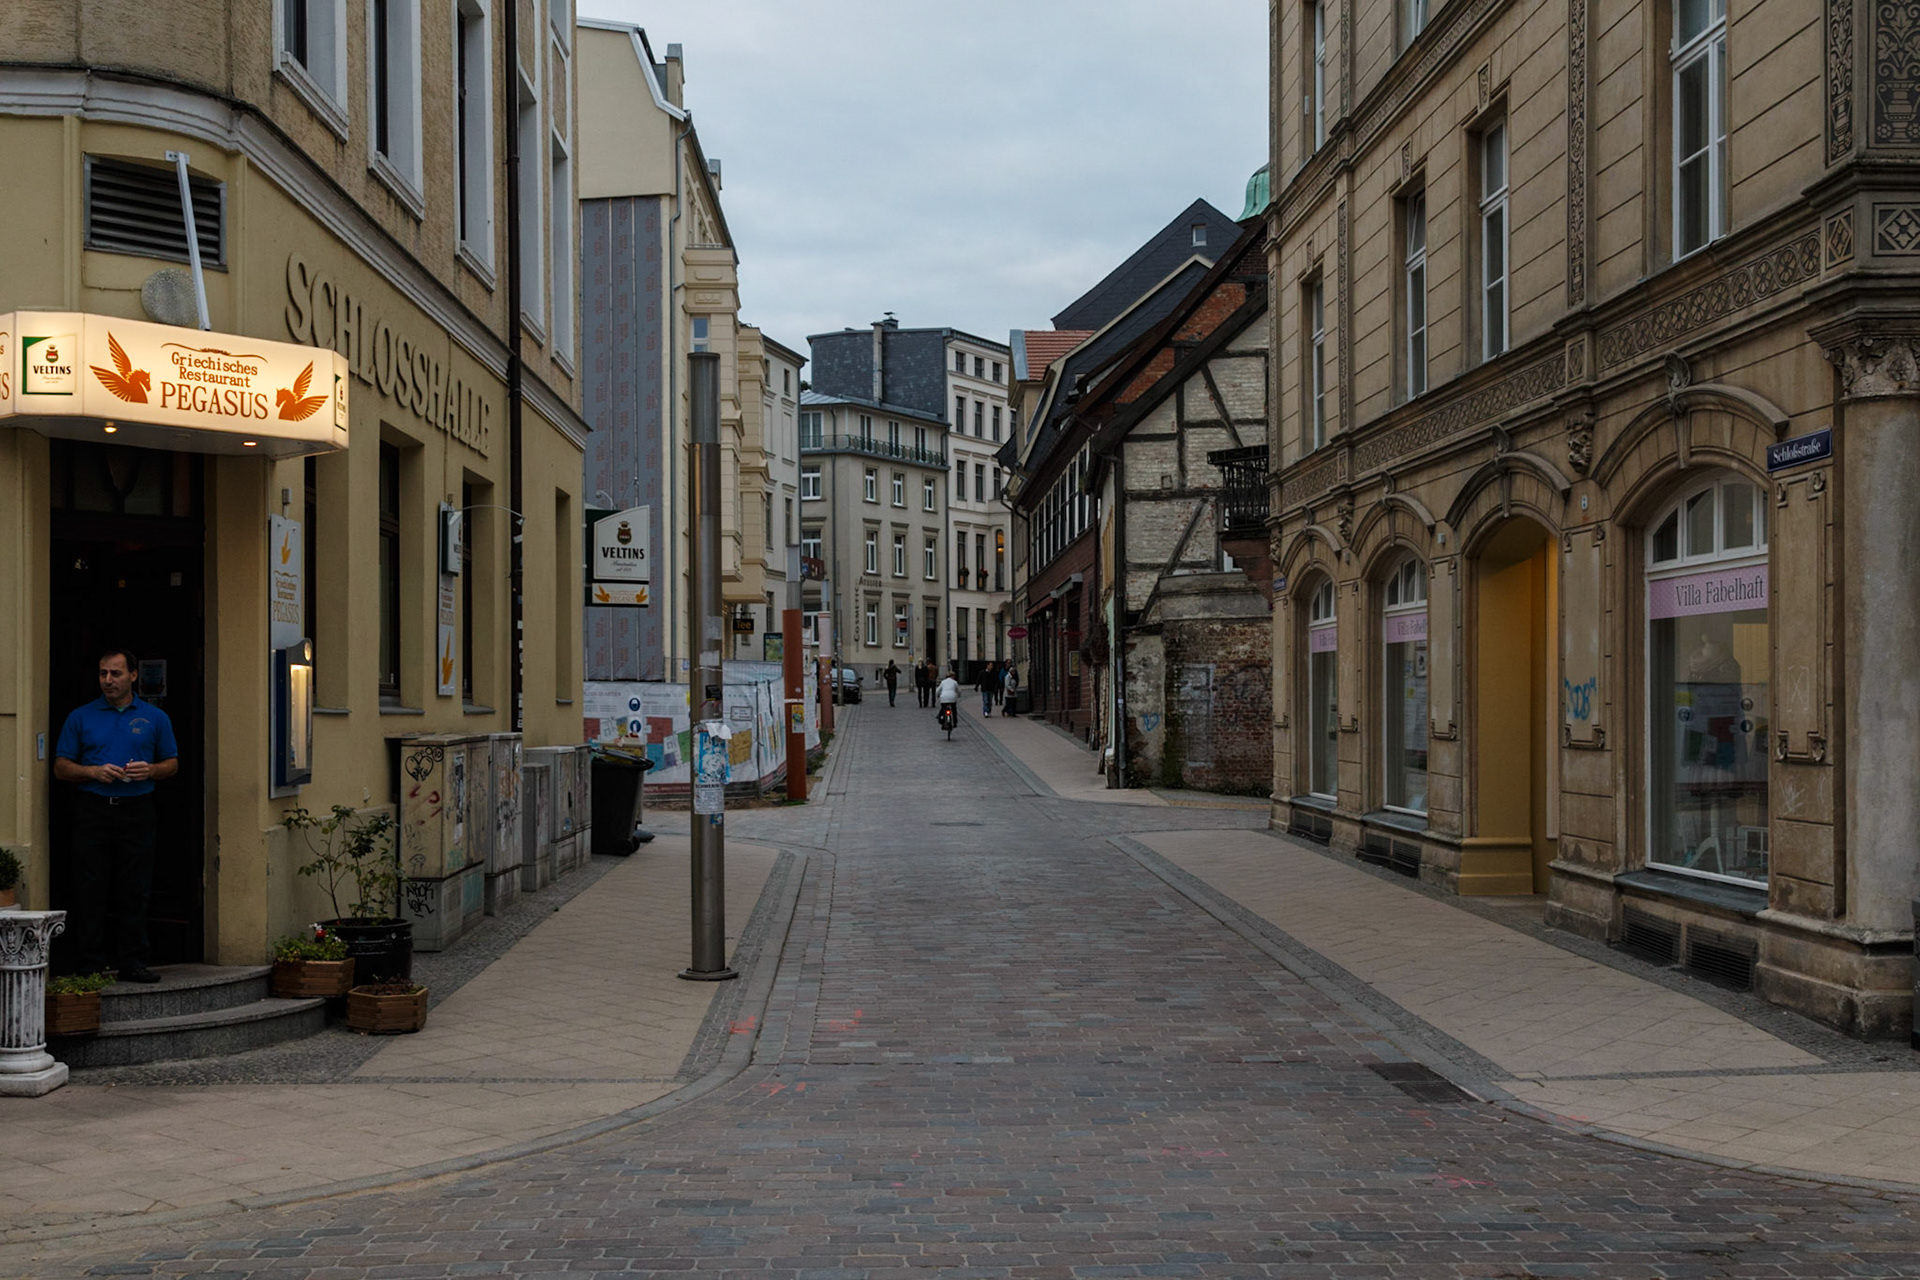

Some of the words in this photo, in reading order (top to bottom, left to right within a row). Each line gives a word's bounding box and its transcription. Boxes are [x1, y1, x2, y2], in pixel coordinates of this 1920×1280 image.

[171, 351, 258, 376] Griechisches
[285, 252, 490, 458] SCHLOSSHALLE
[33, 365, 72, 375] VELTINS
[179, 367, 251, 388] Restaurant
[160, 381, 268, 420] PEGASUS
[1773, 437, 1821, 464] Schloßstraße
[602, 546, 645, 560] VELTINS
[1675, 584, 1701, 607] Villa
[1705, 575, 1764, 604] Fabelhaft
[735, 620, 752, 630] Tee
